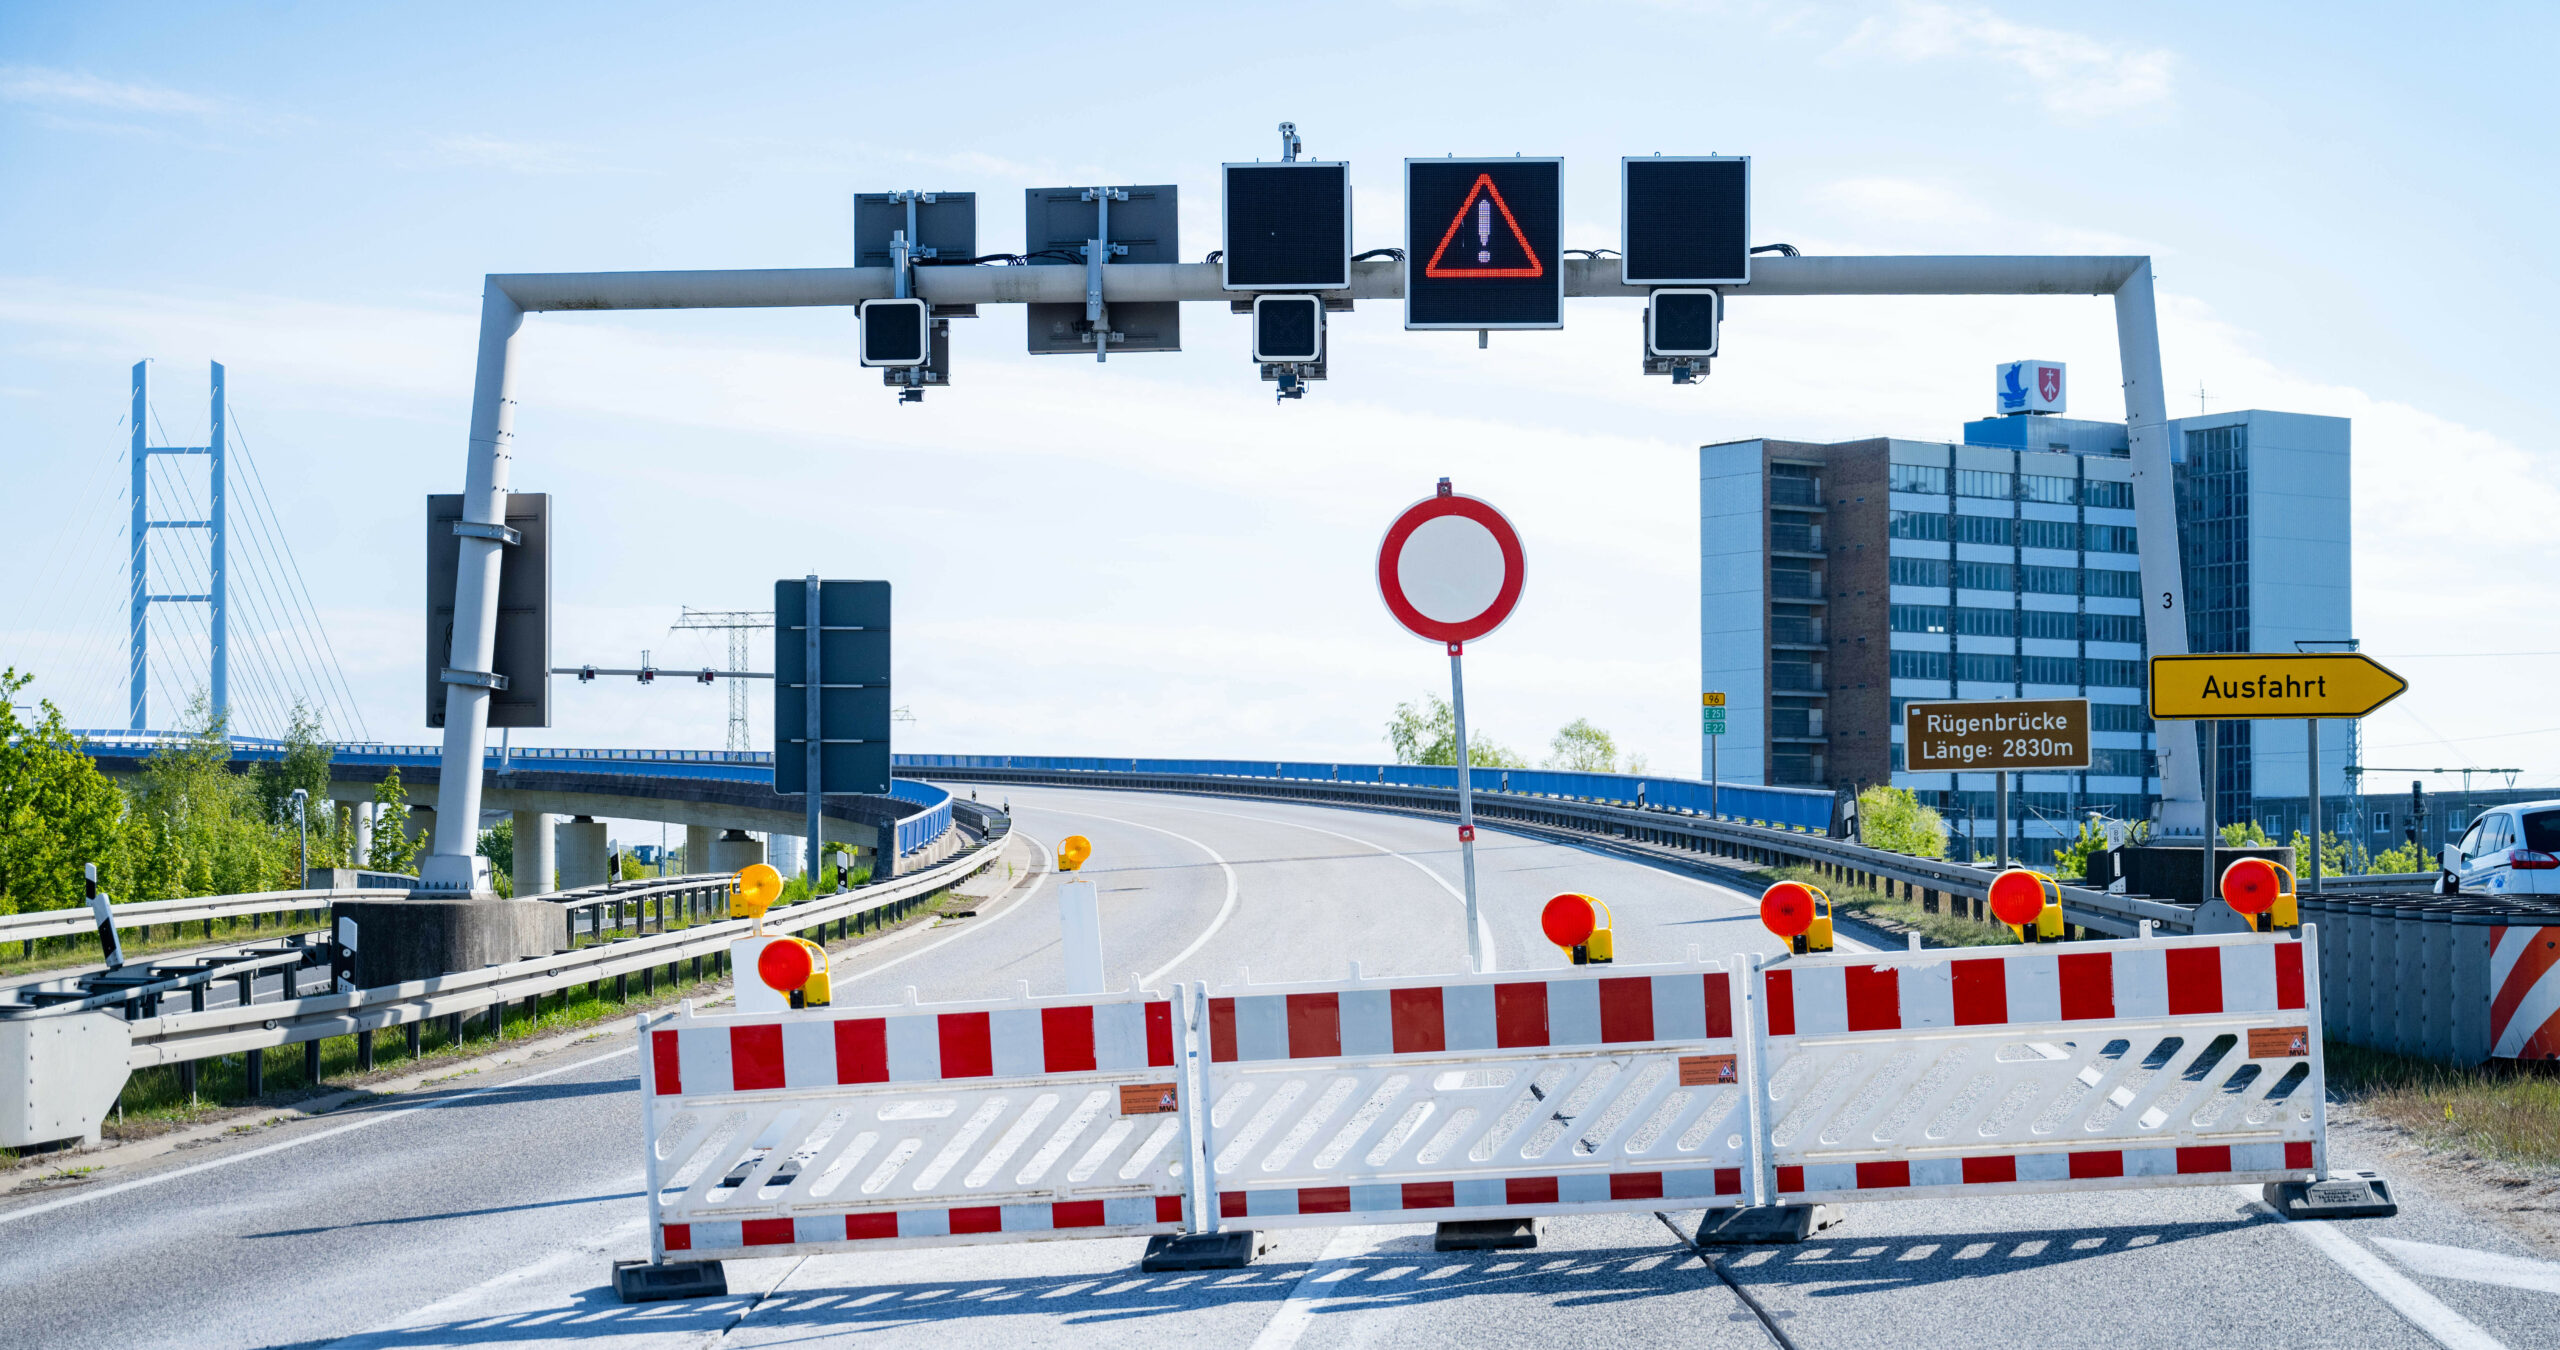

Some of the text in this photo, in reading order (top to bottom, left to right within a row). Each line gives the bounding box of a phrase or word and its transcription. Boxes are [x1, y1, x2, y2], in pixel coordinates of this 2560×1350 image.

[2162, 592, 2173, 609] 3
[2201, 674, 2327, 699] Ausfahrt
[1709, 695, 1720, 704] 96
[1705, 709, 1724, 719] E 251
[1705, 723, 1724, 733] E 22
[1927, 712, 2067, 737] Rügenbrücke
[1923, 738, 2073, 763] Länge: 2830m
